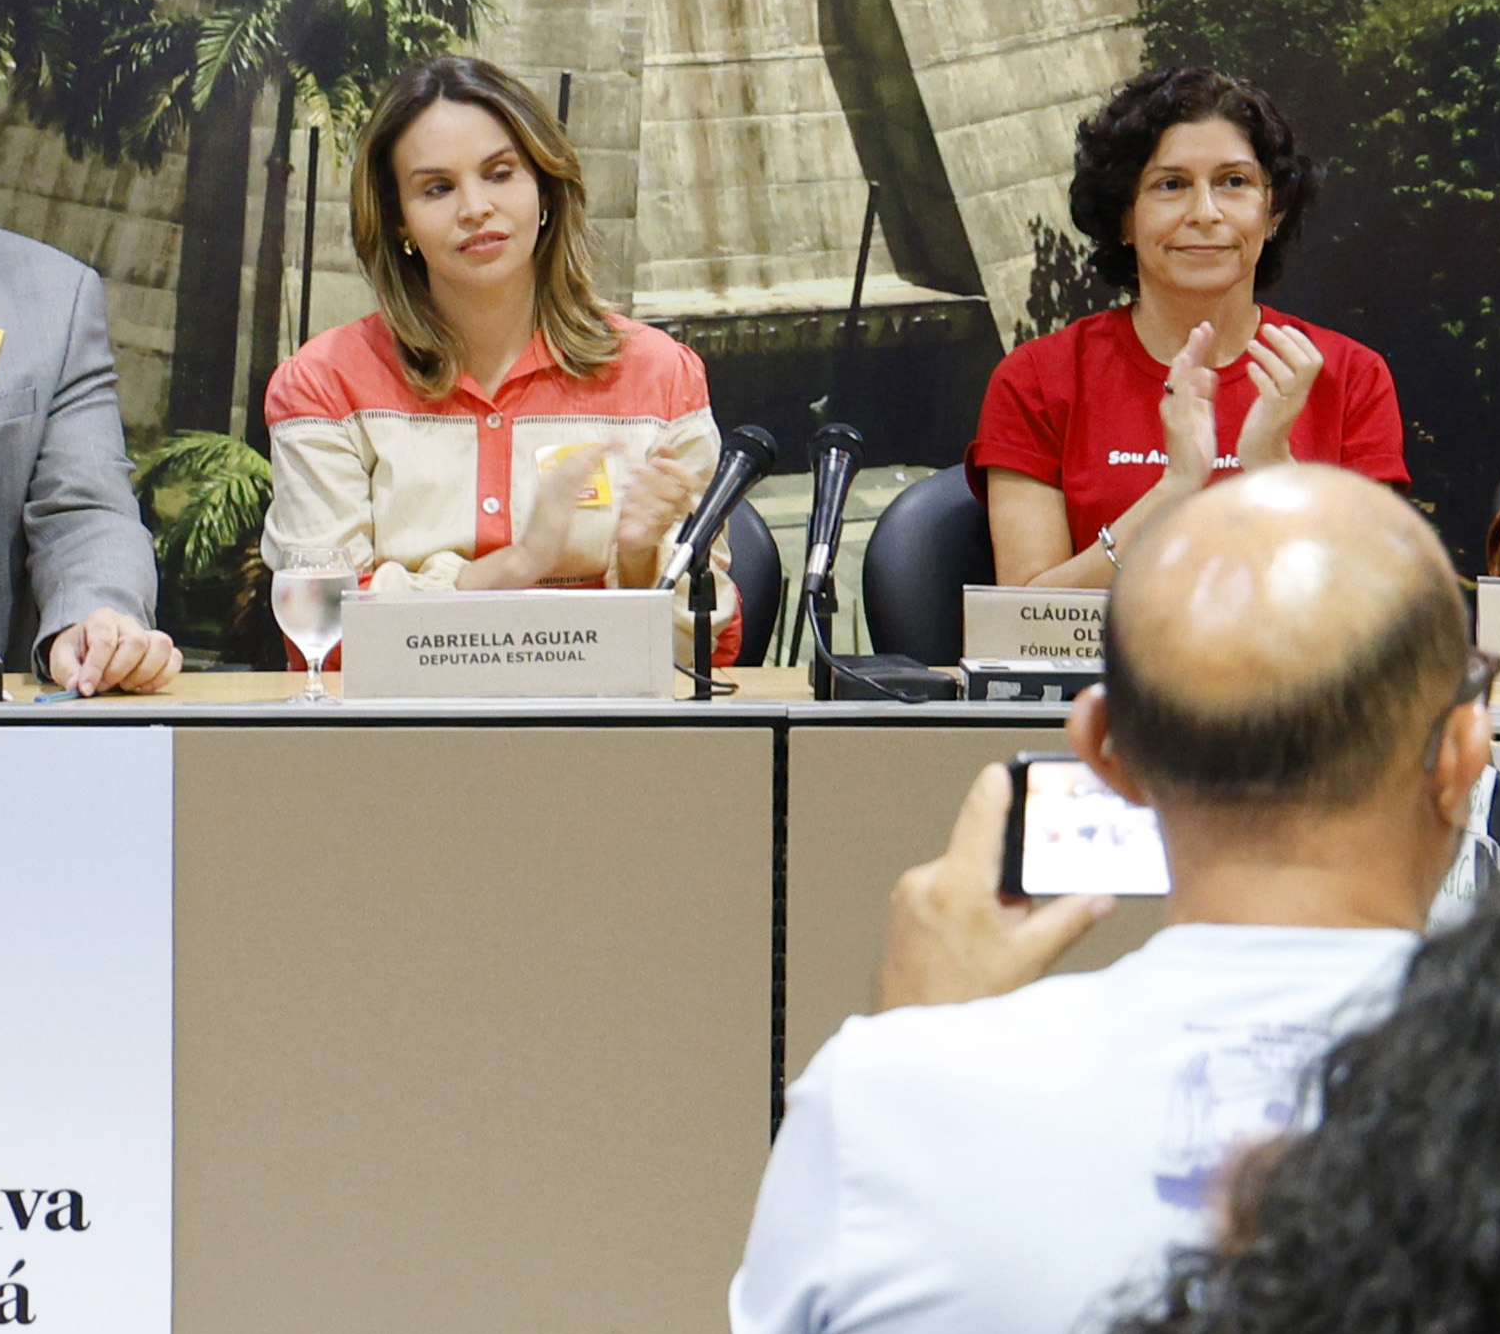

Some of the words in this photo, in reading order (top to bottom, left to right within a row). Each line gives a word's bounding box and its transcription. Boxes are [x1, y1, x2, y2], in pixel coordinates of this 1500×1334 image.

[1108, 449, 1144, 465] Sou
[1020, 603, 1102, 622] CLÁUDIA
[406, 633, 515, 649] GABRIELLA
[521, 629, 599, 646] AGUIAR
[1020, 642, 1071, 656] FÓRUM
[419, 652, 502, 666] DEPUTADA
[506, 650, 586, 664] ESTADUAL
